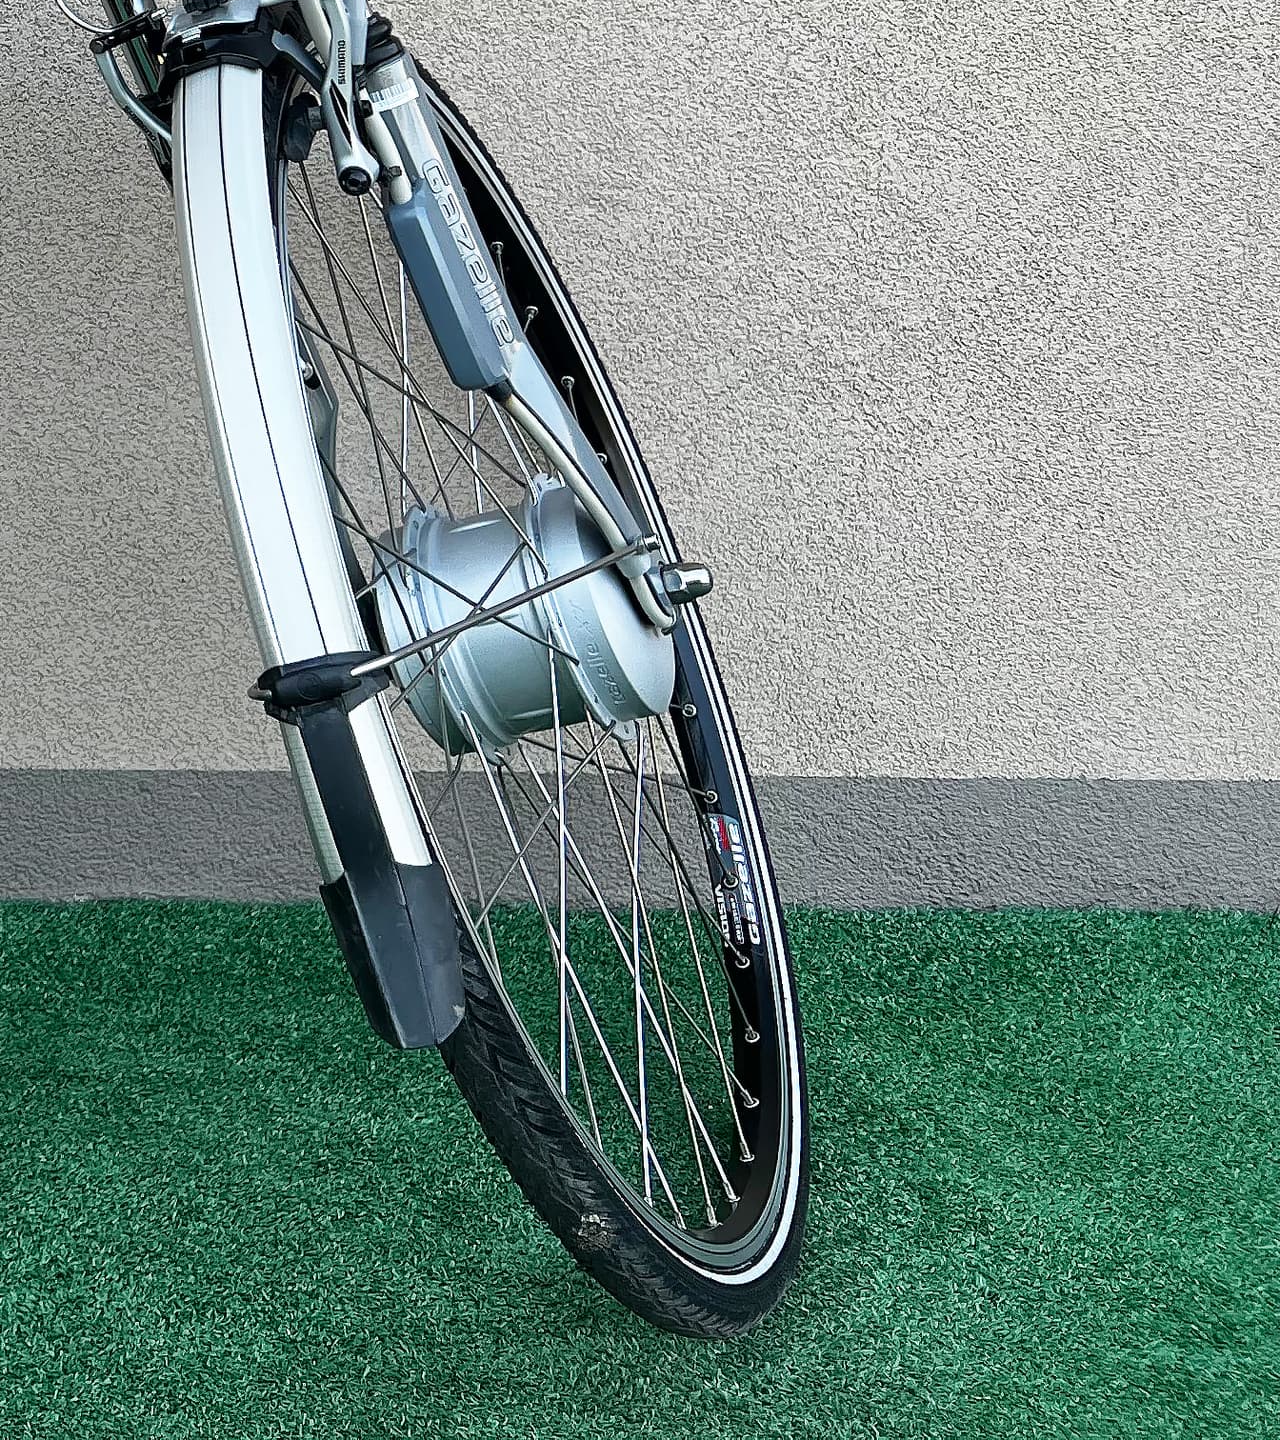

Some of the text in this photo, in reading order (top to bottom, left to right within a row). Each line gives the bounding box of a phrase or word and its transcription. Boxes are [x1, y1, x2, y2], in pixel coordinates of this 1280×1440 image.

[337, 39, 347, 85] SHIMANO
[422, 159, 515, 348] Gazelle
[729, 822, 761, 945] Gazelle
